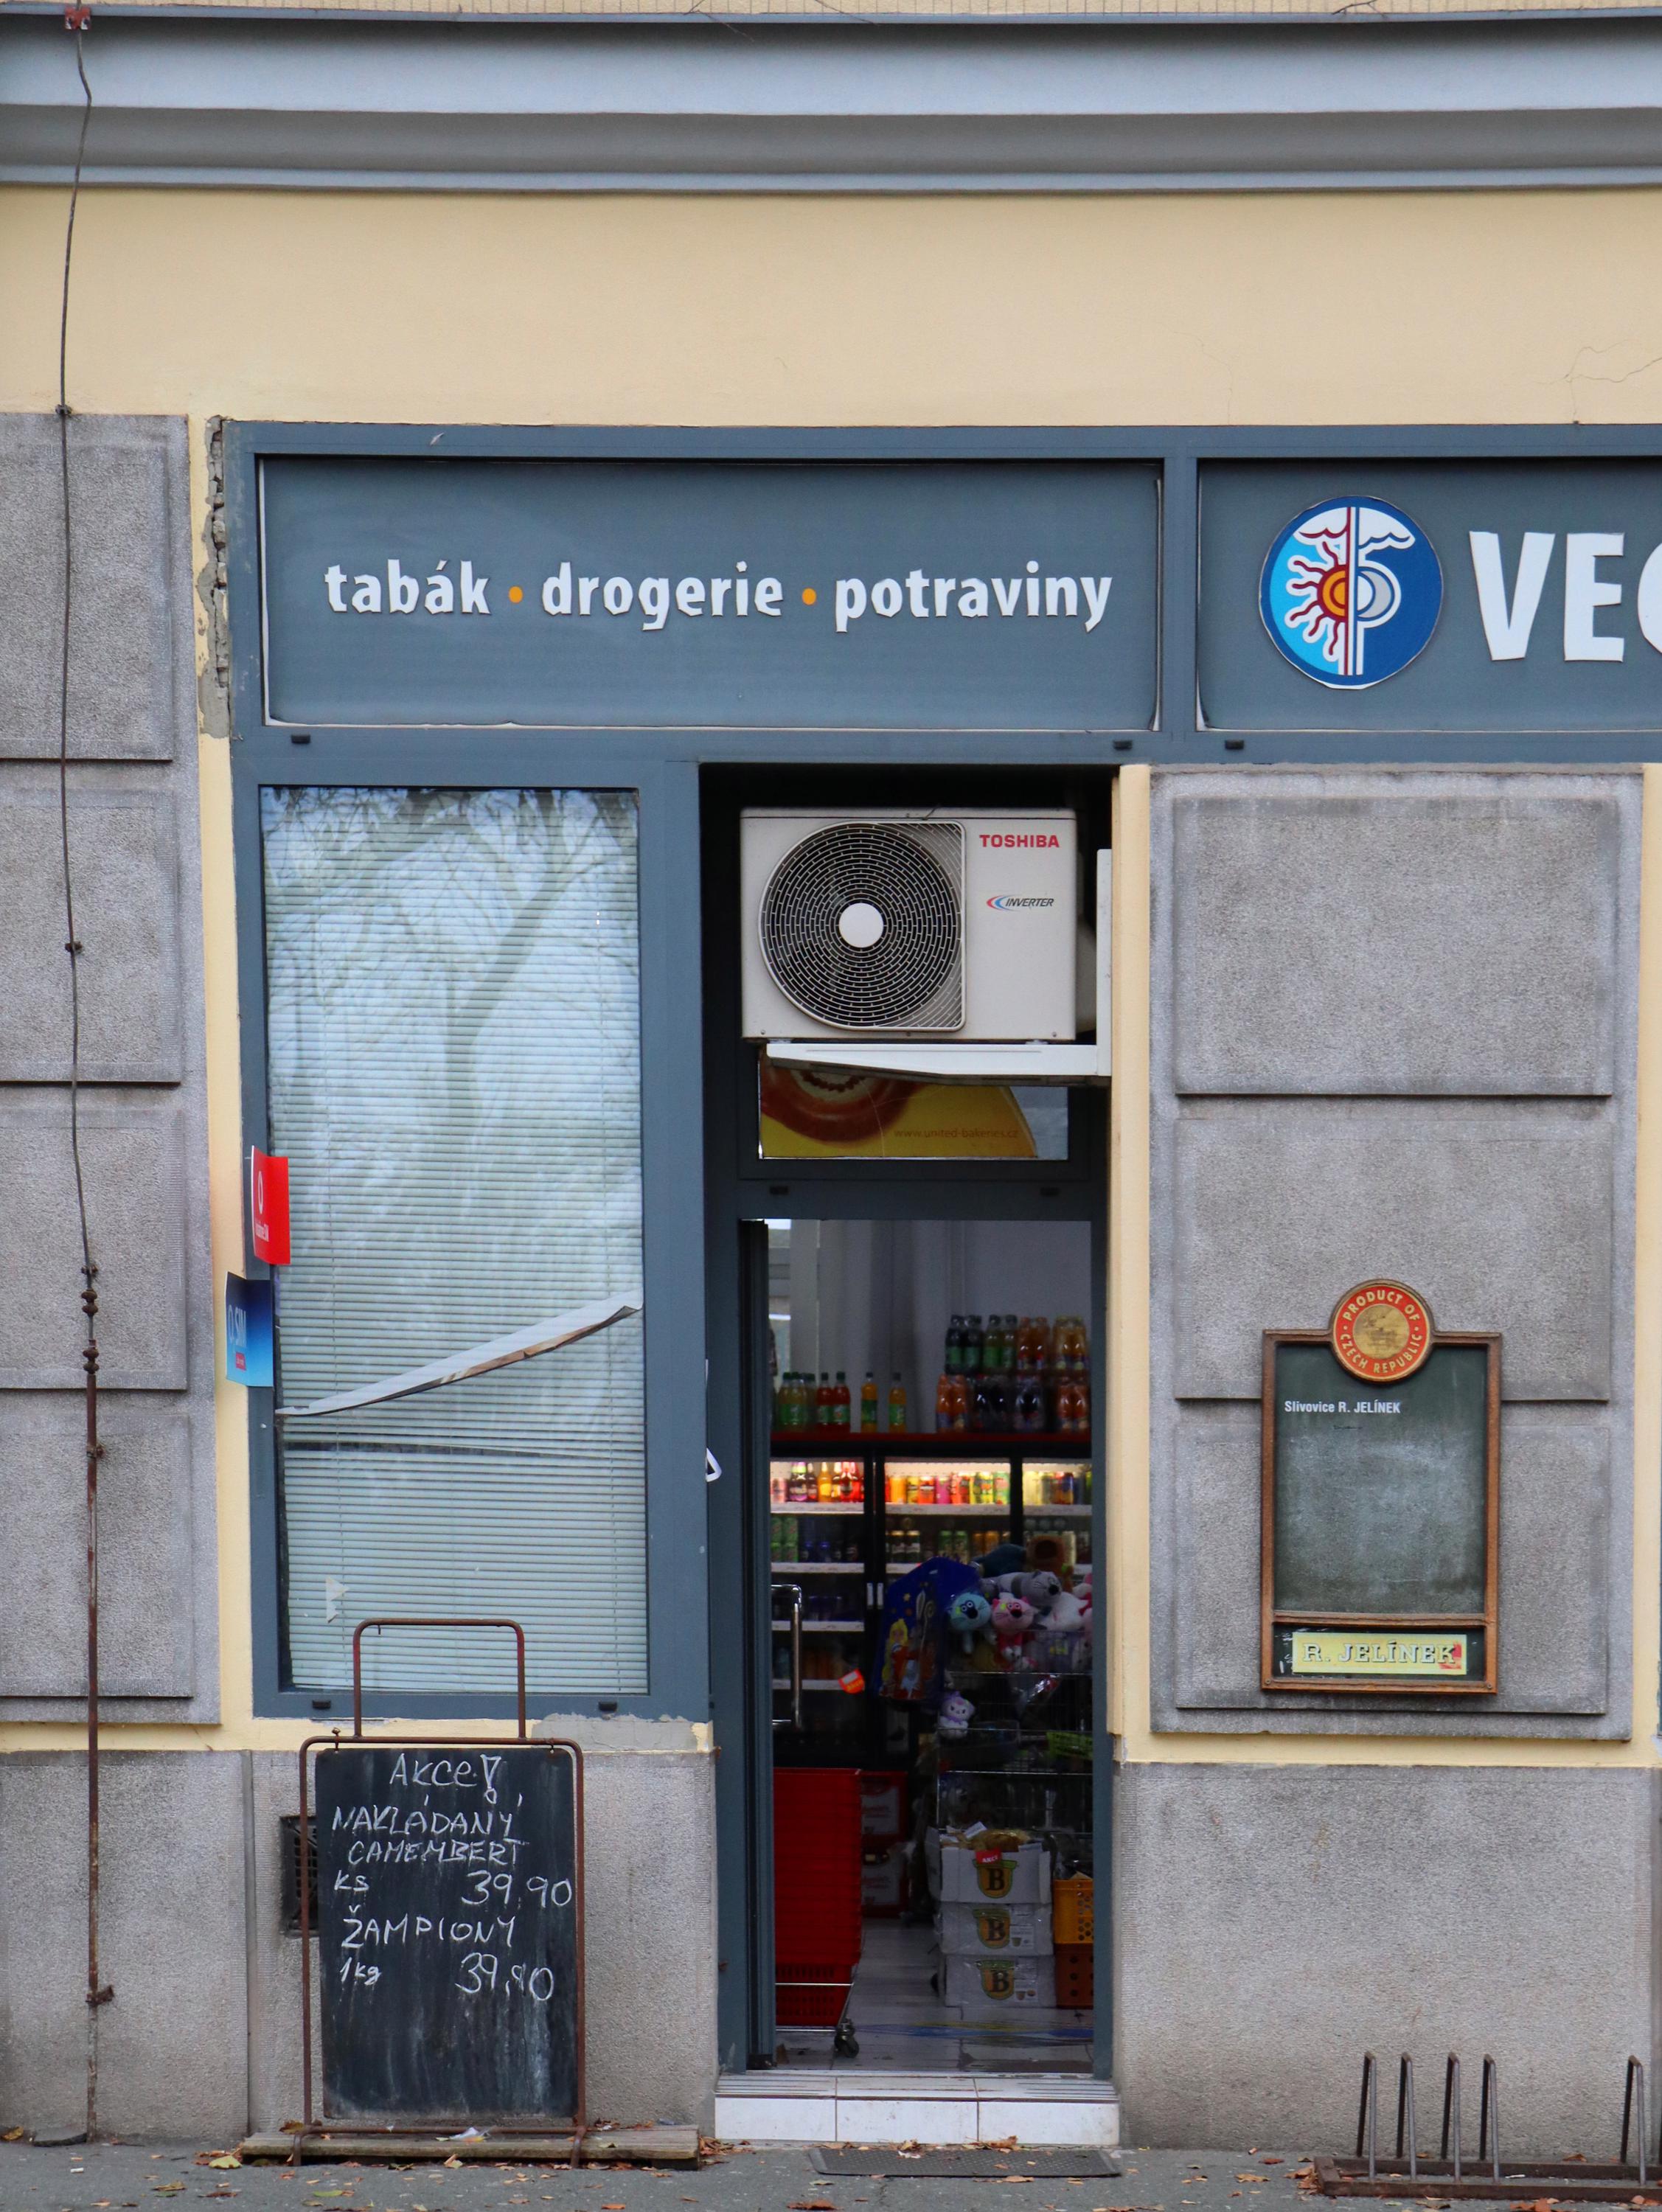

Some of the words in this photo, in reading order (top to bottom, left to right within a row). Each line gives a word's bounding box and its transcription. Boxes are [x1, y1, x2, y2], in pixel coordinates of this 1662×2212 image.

[324, 559, 491, 614] tabák
[542, 561, 783, 631] drogerie
[835, 560, 1113, 633] potraviny
[979, 835, 1060, 848] TOSHIBA
[1005, 898, 1054, 907] INVERTER
[1342, 1290, 1403, 1321] PRODUCT
[1405, 1304, 1420, 1321] OF
[1341, 1333, 1369, 1369] CZECH
[1373, 1333, 1423, 1374] REPUBLIC
[1284, 1400, 1335, 1413] Slivovice
[1338, 1401, 1351, 1413] R.
[1354, 1399, 1401, 1413] JELÍNEK
[1303, 1643, 1331, 1662] R.
[1338, 1639, 1456, 1664] JELÍNEK
[348, 1837, 530, 1866] CAMEMBERT
[341, 1904, 516, 1948] ŽAMPIONY
